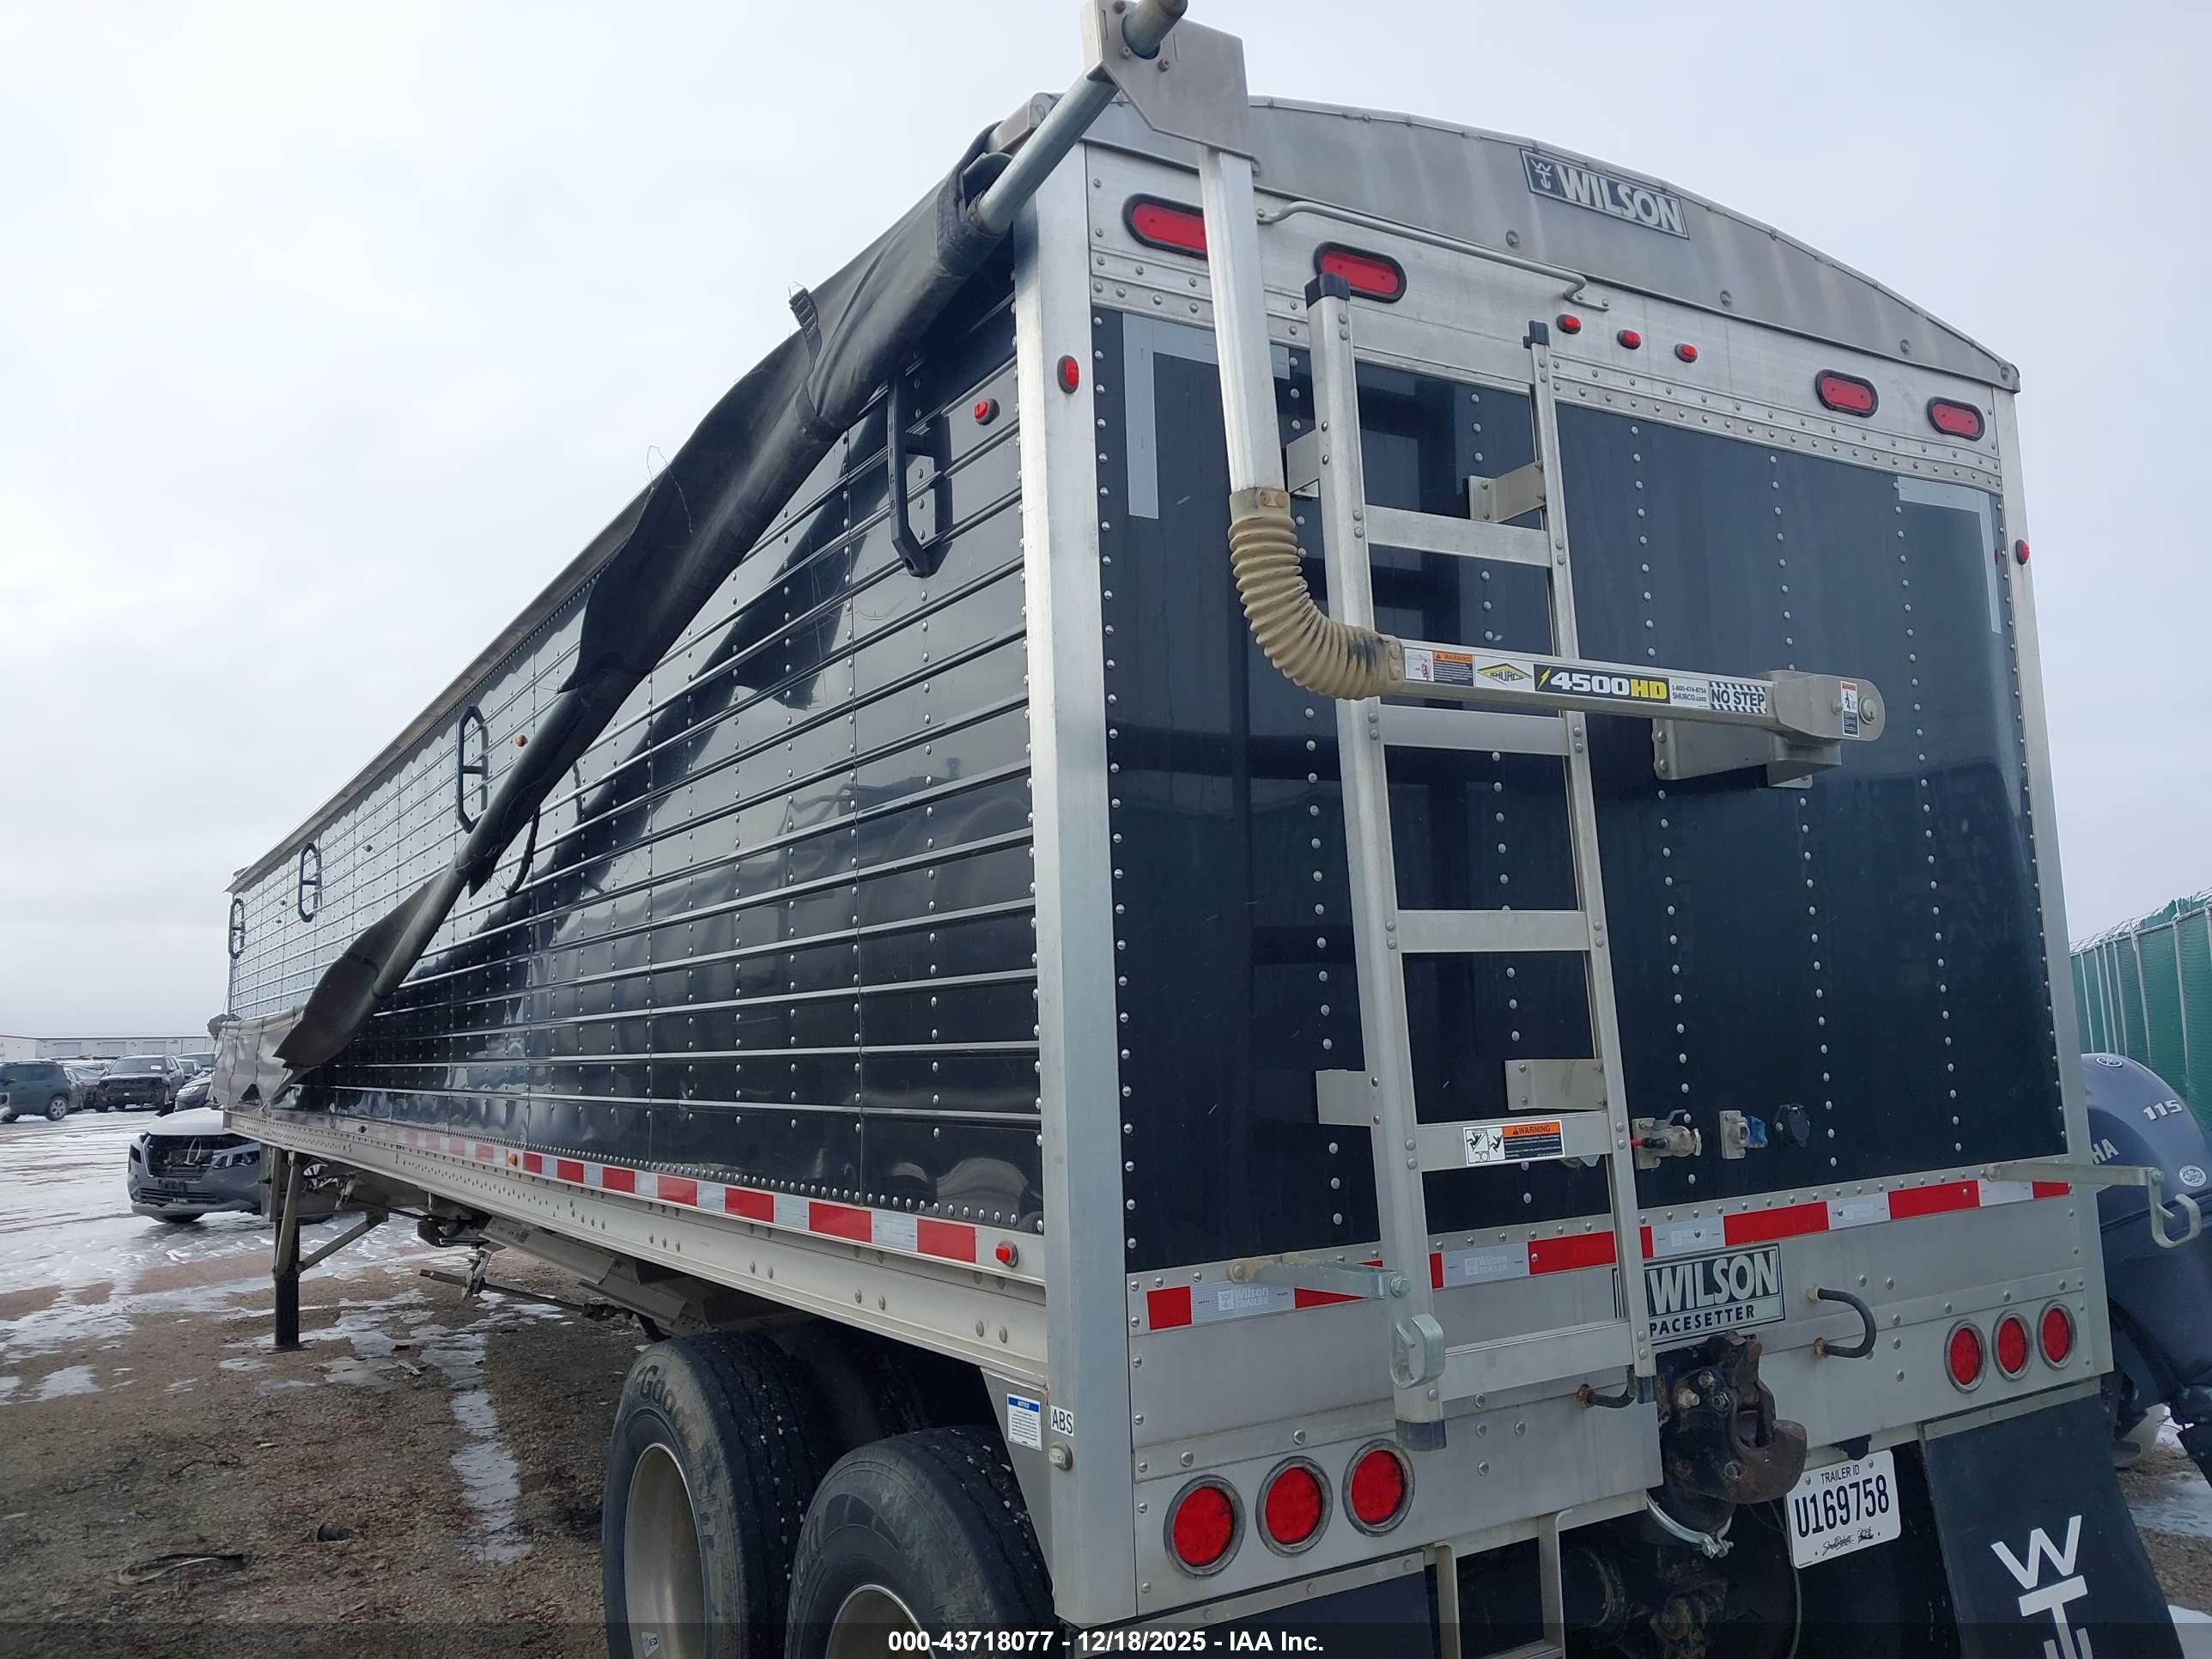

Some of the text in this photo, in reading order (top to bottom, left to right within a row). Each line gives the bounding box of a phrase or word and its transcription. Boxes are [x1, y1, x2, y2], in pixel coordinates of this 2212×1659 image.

[1556, 164, 1685, 234] WILSON
[1550, 672, 1668, 700] 4500HD
[1672, 692, 1707, 702] SHURCO.com
[1711, 689, 1765, 707] NO STEP
[2143, 1100, 2183, 1121] 115
[1517, 1124, 1551, 1134] WARNING
[1648, 1249, 1779, 1316] WILSON
[1650, 1304, 1754, 1337] PACESETTER
[1052, 1409, 1073, 1435] ABS
[1820, 1464, 1860, 1485] TRAILER ID
[1794, 1474, 1889, 1538] U169758
